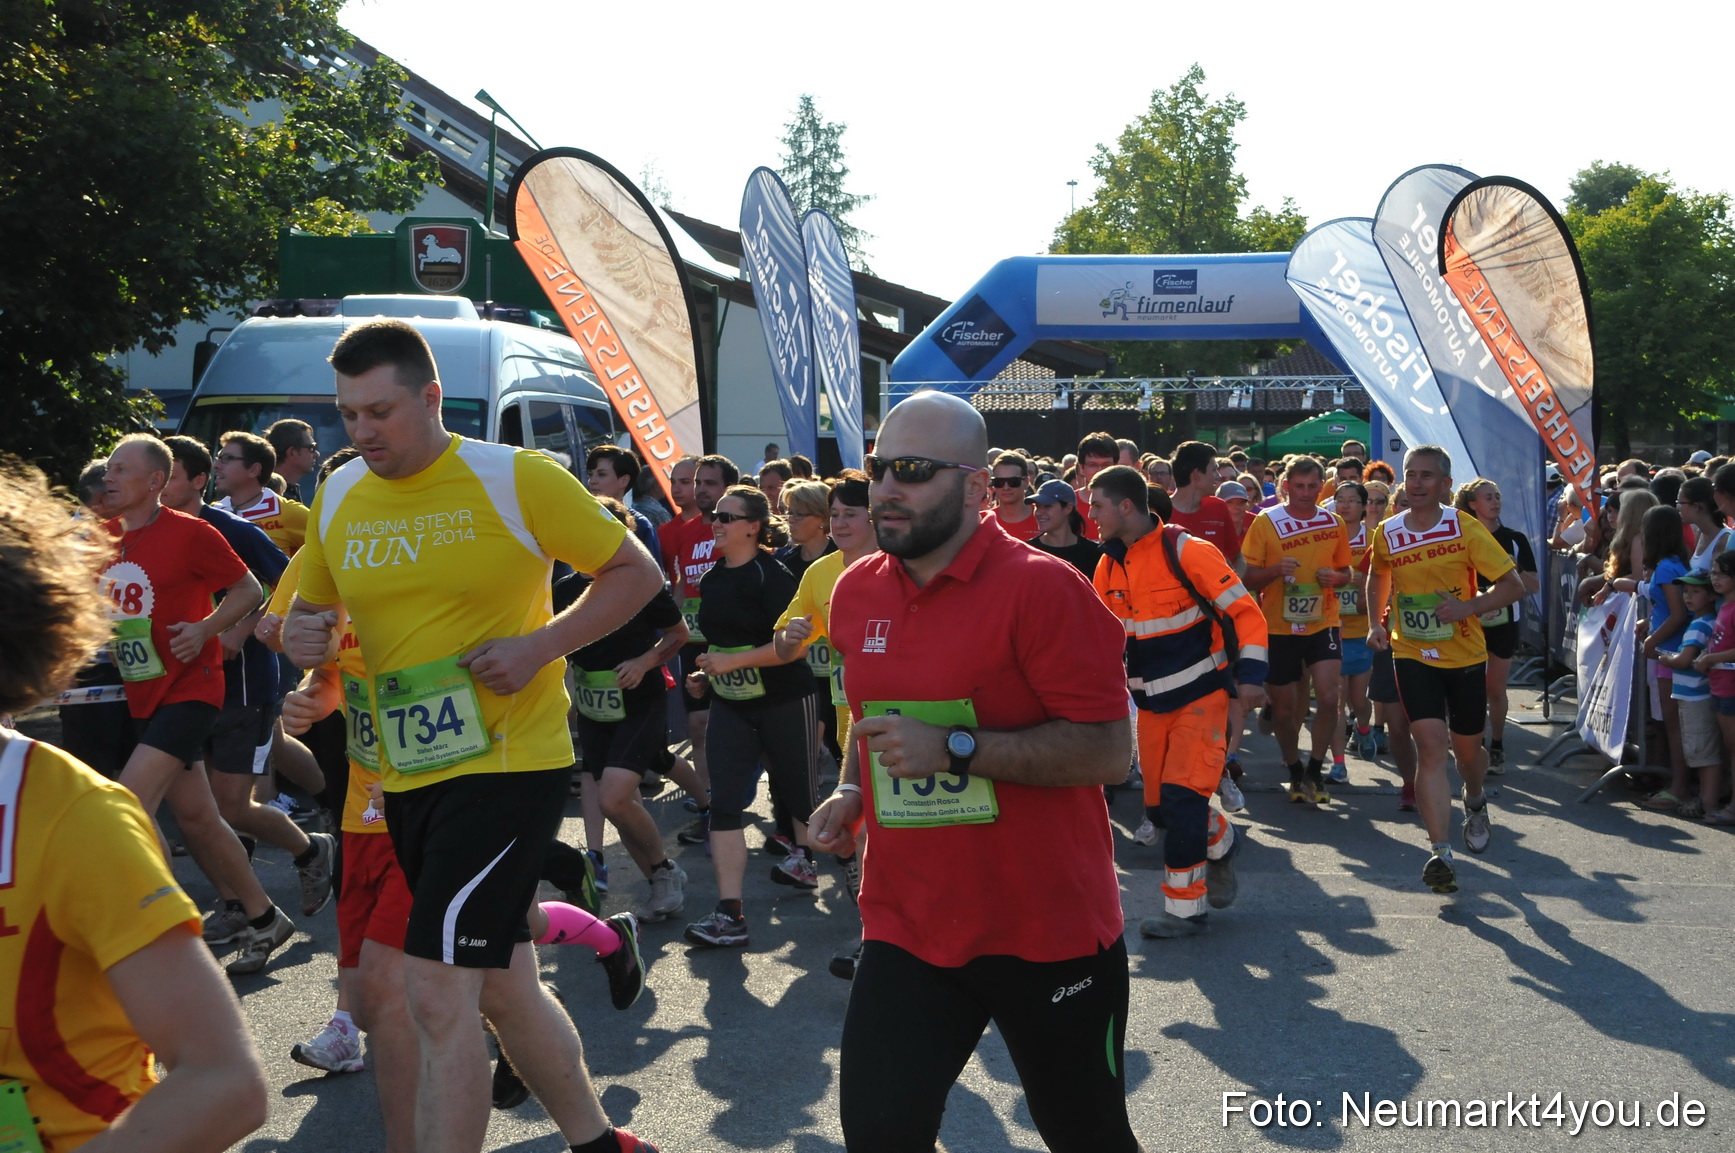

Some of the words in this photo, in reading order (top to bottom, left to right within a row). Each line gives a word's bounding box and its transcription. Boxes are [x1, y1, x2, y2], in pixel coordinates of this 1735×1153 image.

[1161, 279, 1195, 287] Fischer
[1136, 294, 1236, 314] firmenlauf
[1136, 313, 1178, 321] neumarkt
[951, 329, 1004, 341] Fischer
[345, 519, 409, 537] MAGNA
[413, 509, 474, 532] STEYR
[432, 527, 476, 546] 2014
[1281, 536, 1310, 552] MAX
[1313, 530, 1340, 543] BÖGL
[341, 533, 426, 570] RUN
[1391, 551, 1423, 569] MAX
[1426, 542, 1466, 559] BÖGL
[1288, 597, 1319, 614] 827
[1403, 610, 1441, 630] 801
[713, 667, 758, 688] 1090
[575, 685, 621, 710] 1075
[349, 705, 379, 748] 78
[386, 696, 466, 749] 734
[397, 760, 412, 768] Magna
[412, 757, 425, 766] Steyr
[436, 750, 460, 761] Systems
[460, 744, 479, 753] GmbH
[416, 747, 432, 755] Stefan
[433, 743, 449, 752] März
[902, 799, 937, 807] Constantin
[936, 797, 960, 806] Rosca
[893, 810, 906, 818] Bögl
[938, 808, 959, 816] GmbH
[468, 938, 487, 947] JAKO
[1066, 975, 1092, 996] asics
